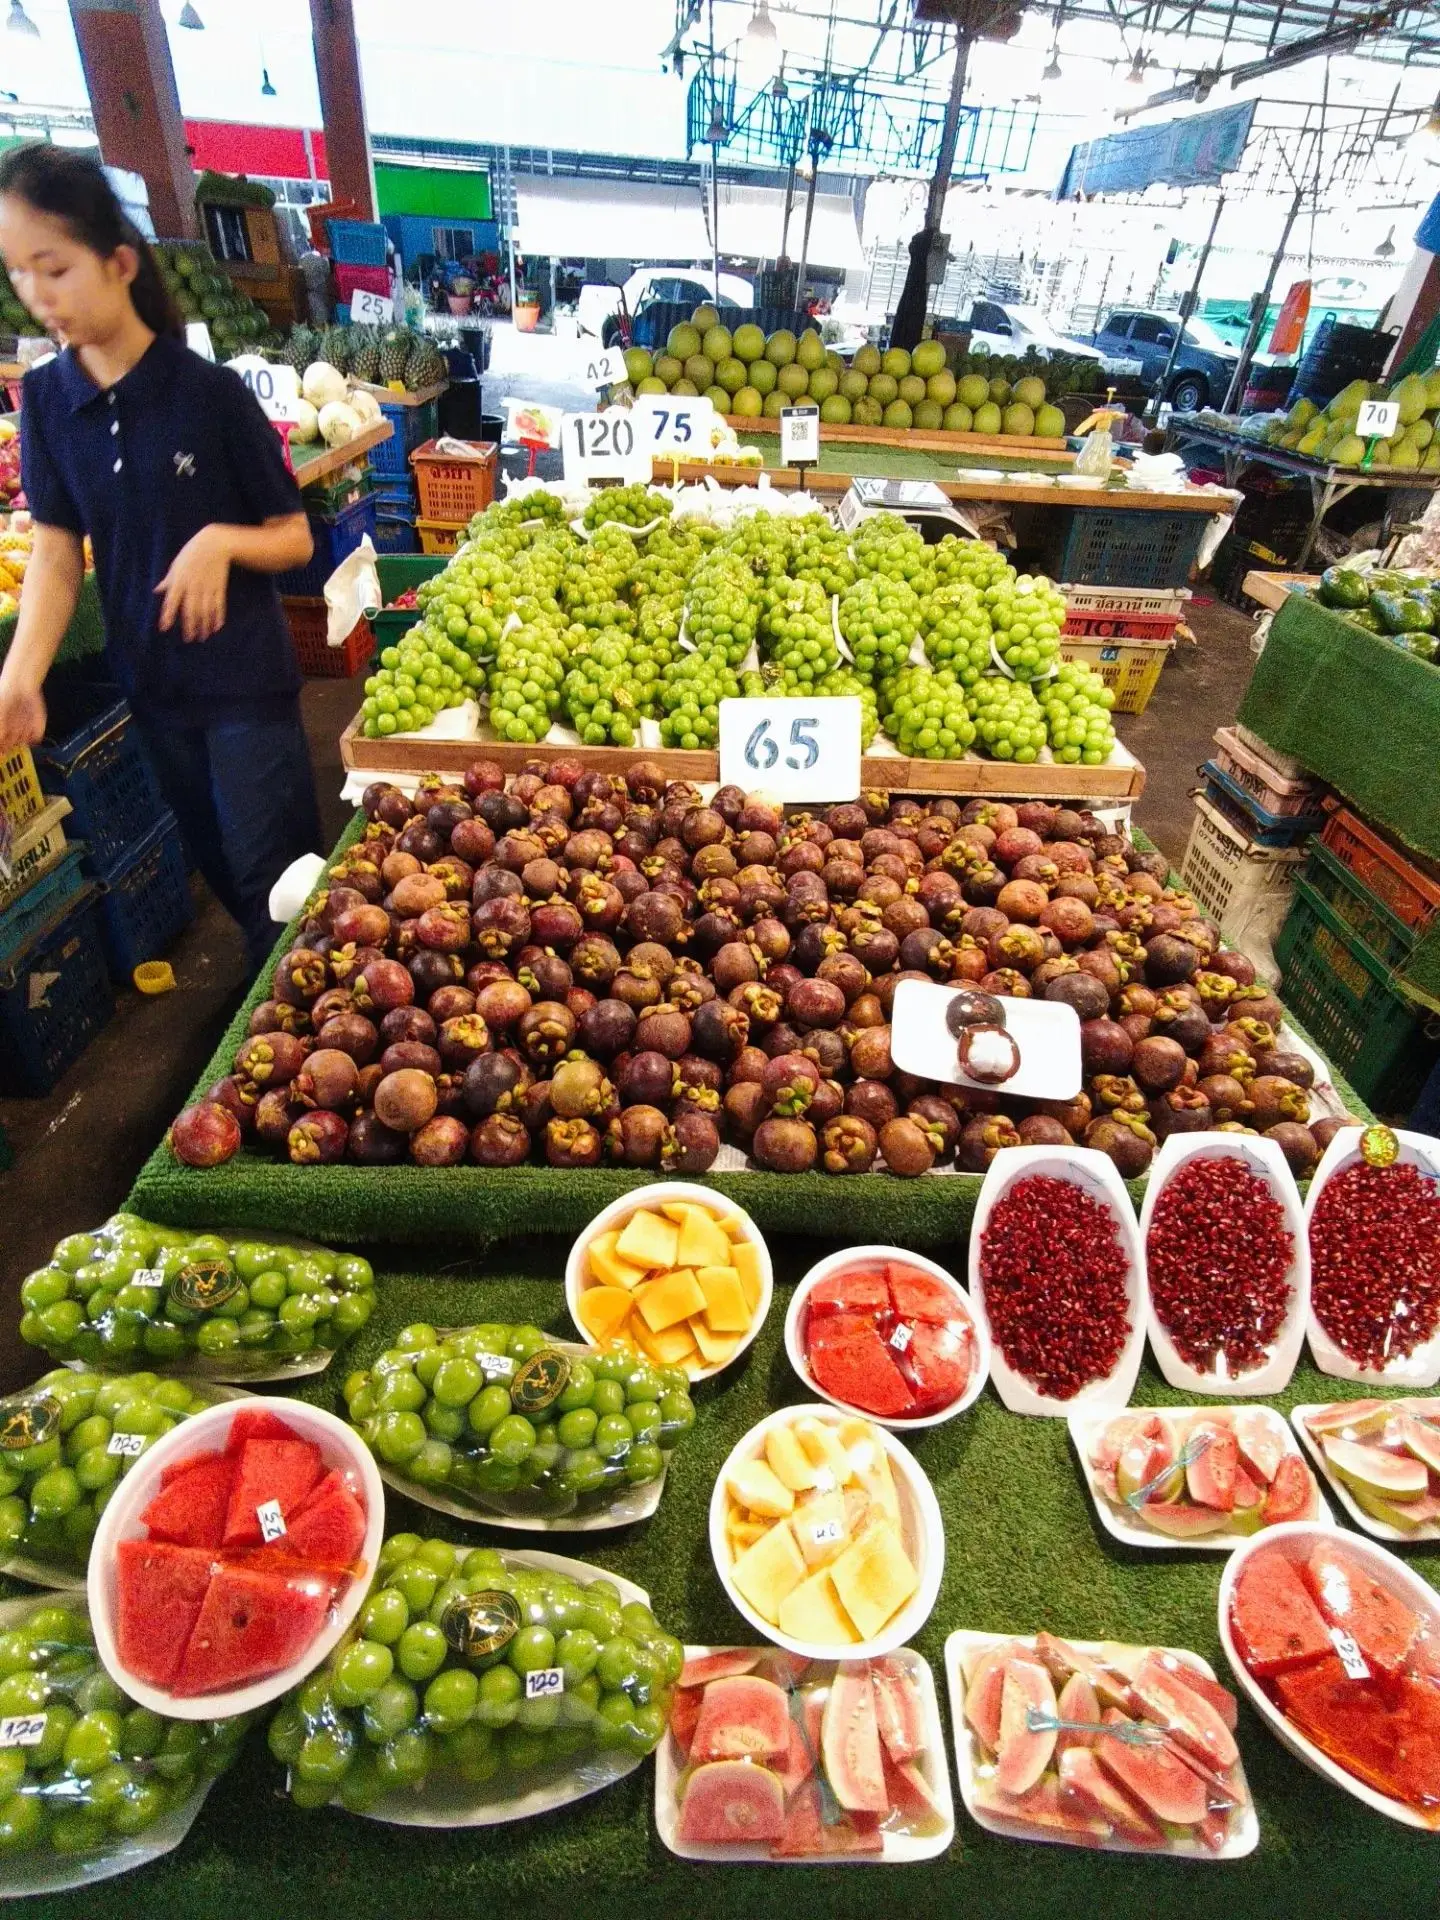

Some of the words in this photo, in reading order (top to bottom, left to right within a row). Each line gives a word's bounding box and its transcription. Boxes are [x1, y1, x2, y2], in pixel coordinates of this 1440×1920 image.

[361, 294, 384, 316] 25
[587, 357, 613, 380] 42
[1366, 404, 1388, 424] 70
[653, 410, 692, 442] 75
[574, 418, 634, 457] 120
[744, 718, 820, 770] 65
[139, 1270, 161, 1283] 120
[487, 1356, 509, 1369] 120
[265, 1512, 282, 1537] 25
[528, 1671, 559, 1692] 120
[6, 1720, 43, 1738] 120
